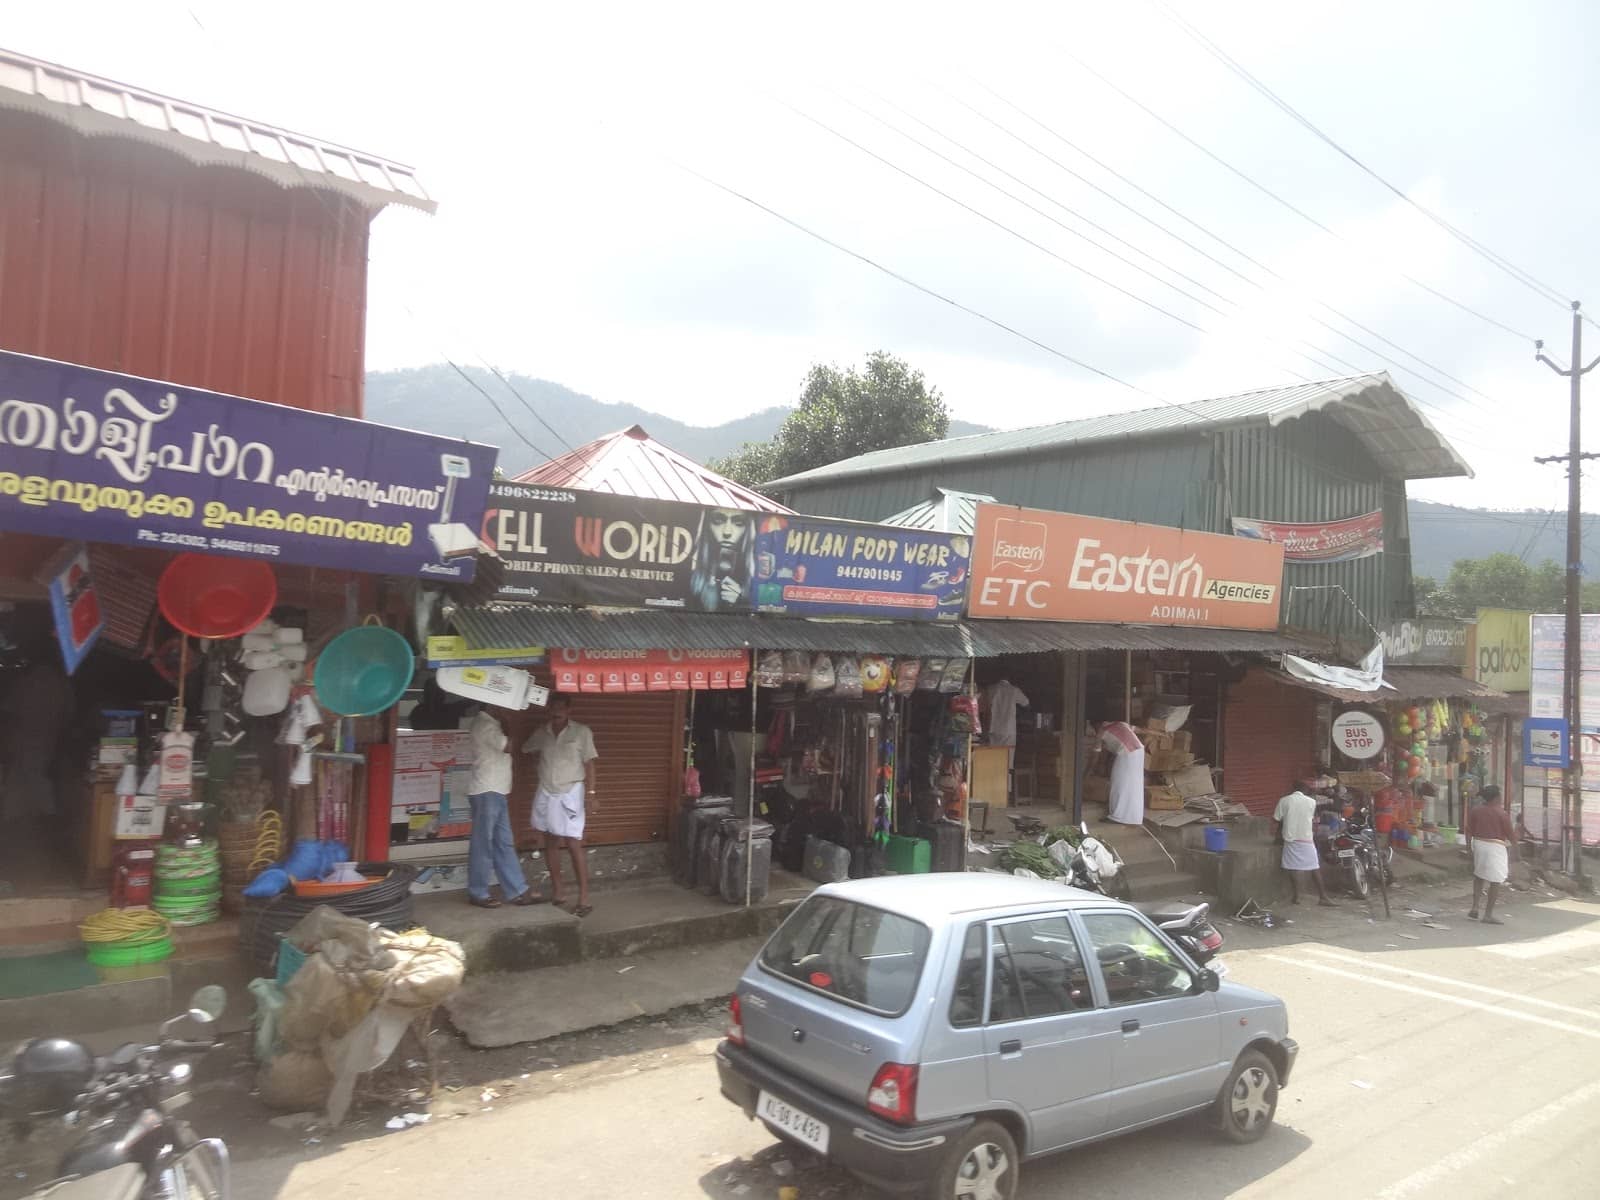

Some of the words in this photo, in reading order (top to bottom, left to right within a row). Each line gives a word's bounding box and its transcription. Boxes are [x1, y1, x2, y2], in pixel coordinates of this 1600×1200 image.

[202, 500, 413, 548] ഉപകരണങ്ങൾ
[480, 508, 548, 554] CELL
[574, 515, 693, 565] WORLD
[785, 529, 848, 558] MILAN
[852, 535, 899, 563] FOOT
[903, 542, 949, 567] WEAR
[995, 540, 1043, 562] Eastern
[543, 562, 585, 576] PHONE
[585, 565, 618, 578] SALES
[629, 568, 674, 581] SERVICE
[837, 566, 903, 581] 9447901945
[1067, 538, 1204, 598] Eastern
[1207, 580, 1271, 600] Agencies
[979, 577, 1051, 609] ETC
[1345, 728, 1368, 738] BUS
[1345, 738, 1374, 748] STOP
